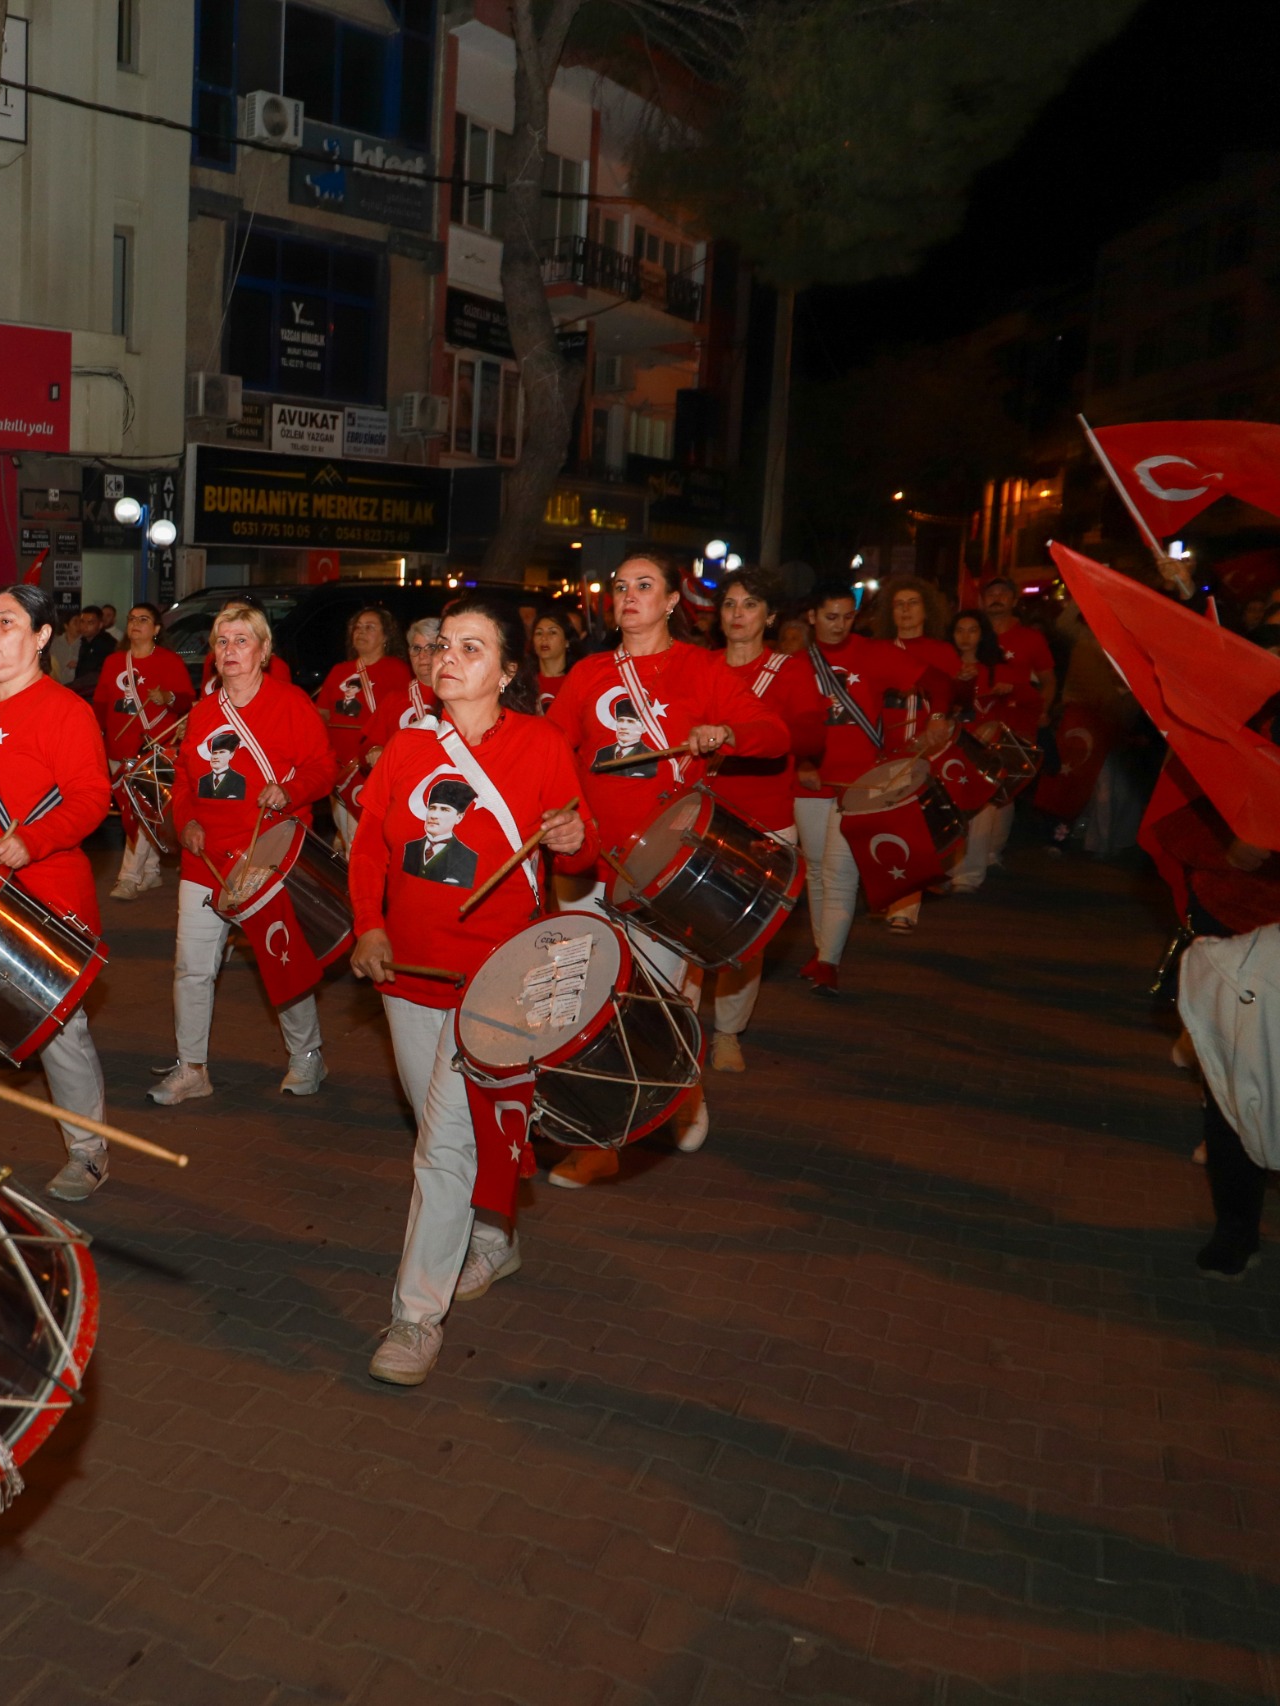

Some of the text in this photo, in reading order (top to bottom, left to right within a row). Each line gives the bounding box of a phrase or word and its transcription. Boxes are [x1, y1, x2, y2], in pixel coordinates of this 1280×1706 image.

[27, 421, 55, 437] yolu
[277, 408, 340, 431] AVUKAT
[280, 428, 305, 440] ÖZLEM
[204, 485, 434, 524] BURHANİYE MERKEZ EMLAK
[163, 475, 175, 579] AVUAT
[232, 521, 258, 536] 0531
[261, 523, 280, 537] 775
[282, 524, 294, 538] 10
[296, 524, 311, 538] 05
[335, 527, 362, 541] 0543
